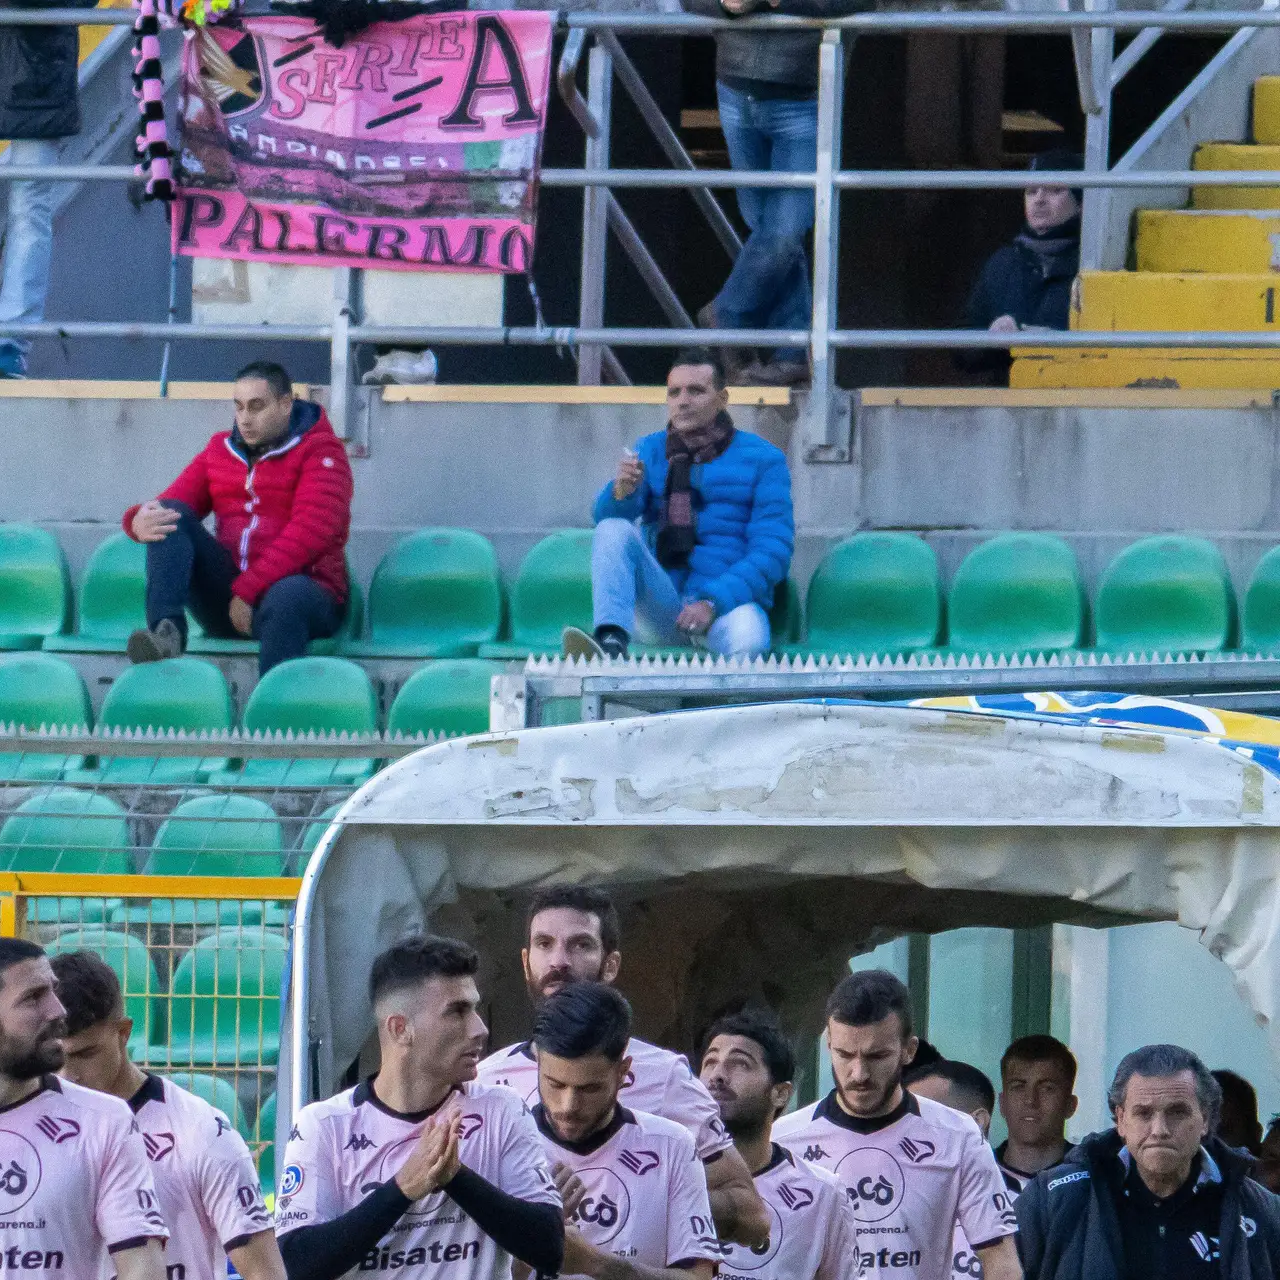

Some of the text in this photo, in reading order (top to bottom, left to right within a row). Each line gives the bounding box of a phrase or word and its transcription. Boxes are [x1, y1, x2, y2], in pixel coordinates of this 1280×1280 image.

[270, 13, 540, 132] SERIE A
[358, 1239, 481, 1272] Bisaten
